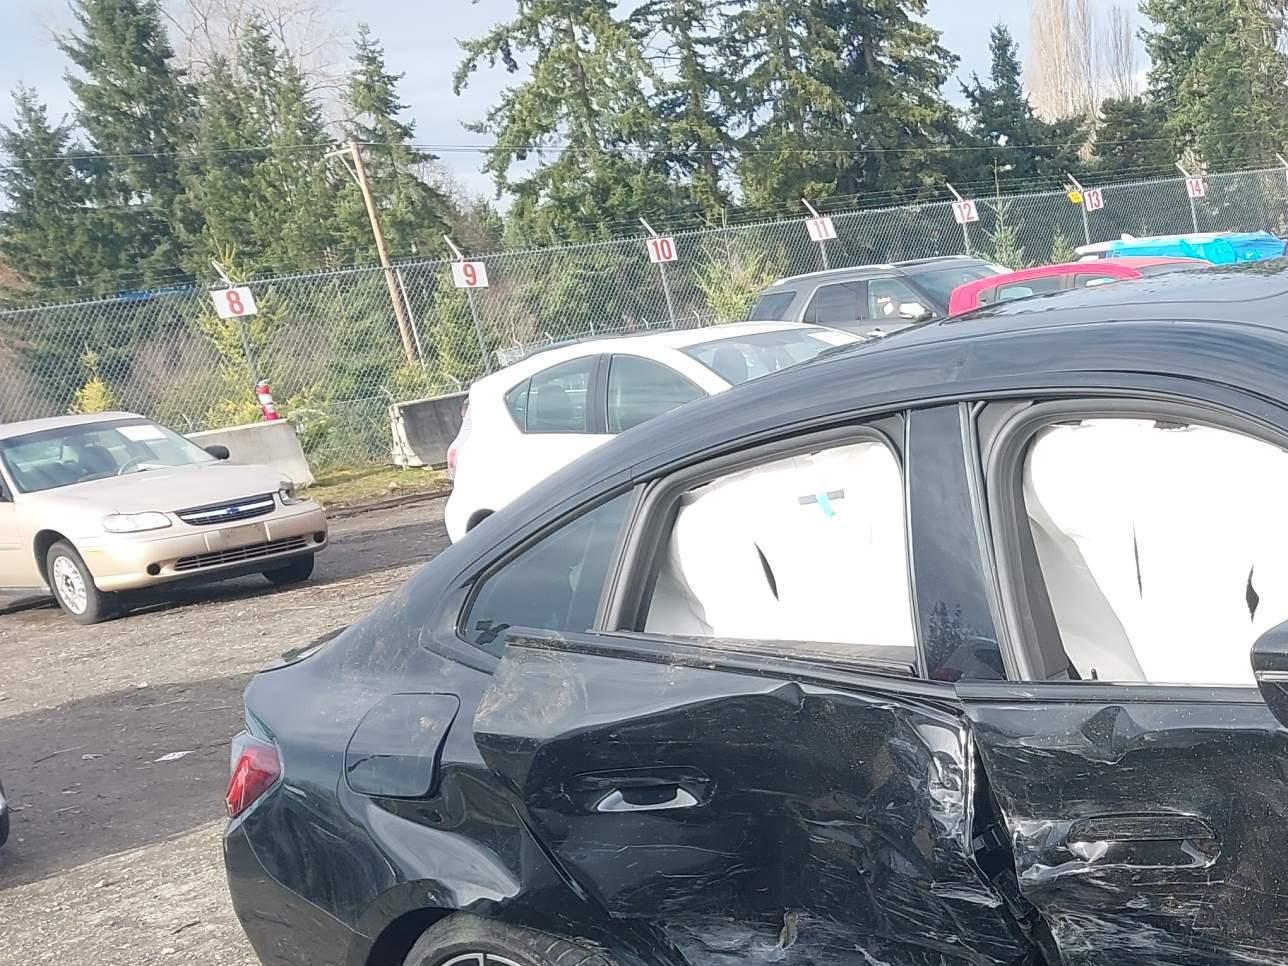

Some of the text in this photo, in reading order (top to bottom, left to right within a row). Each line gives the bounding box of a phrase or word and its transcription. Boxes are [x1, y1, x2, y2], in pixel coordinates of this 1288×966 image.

[1189, 180, 1202, 196] 14
[1087, 191, 1101, 208] 13
[957, 203, 975, 221] 12
[813, 220, 830, 238] 11
[651, 239, 673, 260] 10
[462, 263, 477, 286] 9
[226, 290, 244, 315] 8
